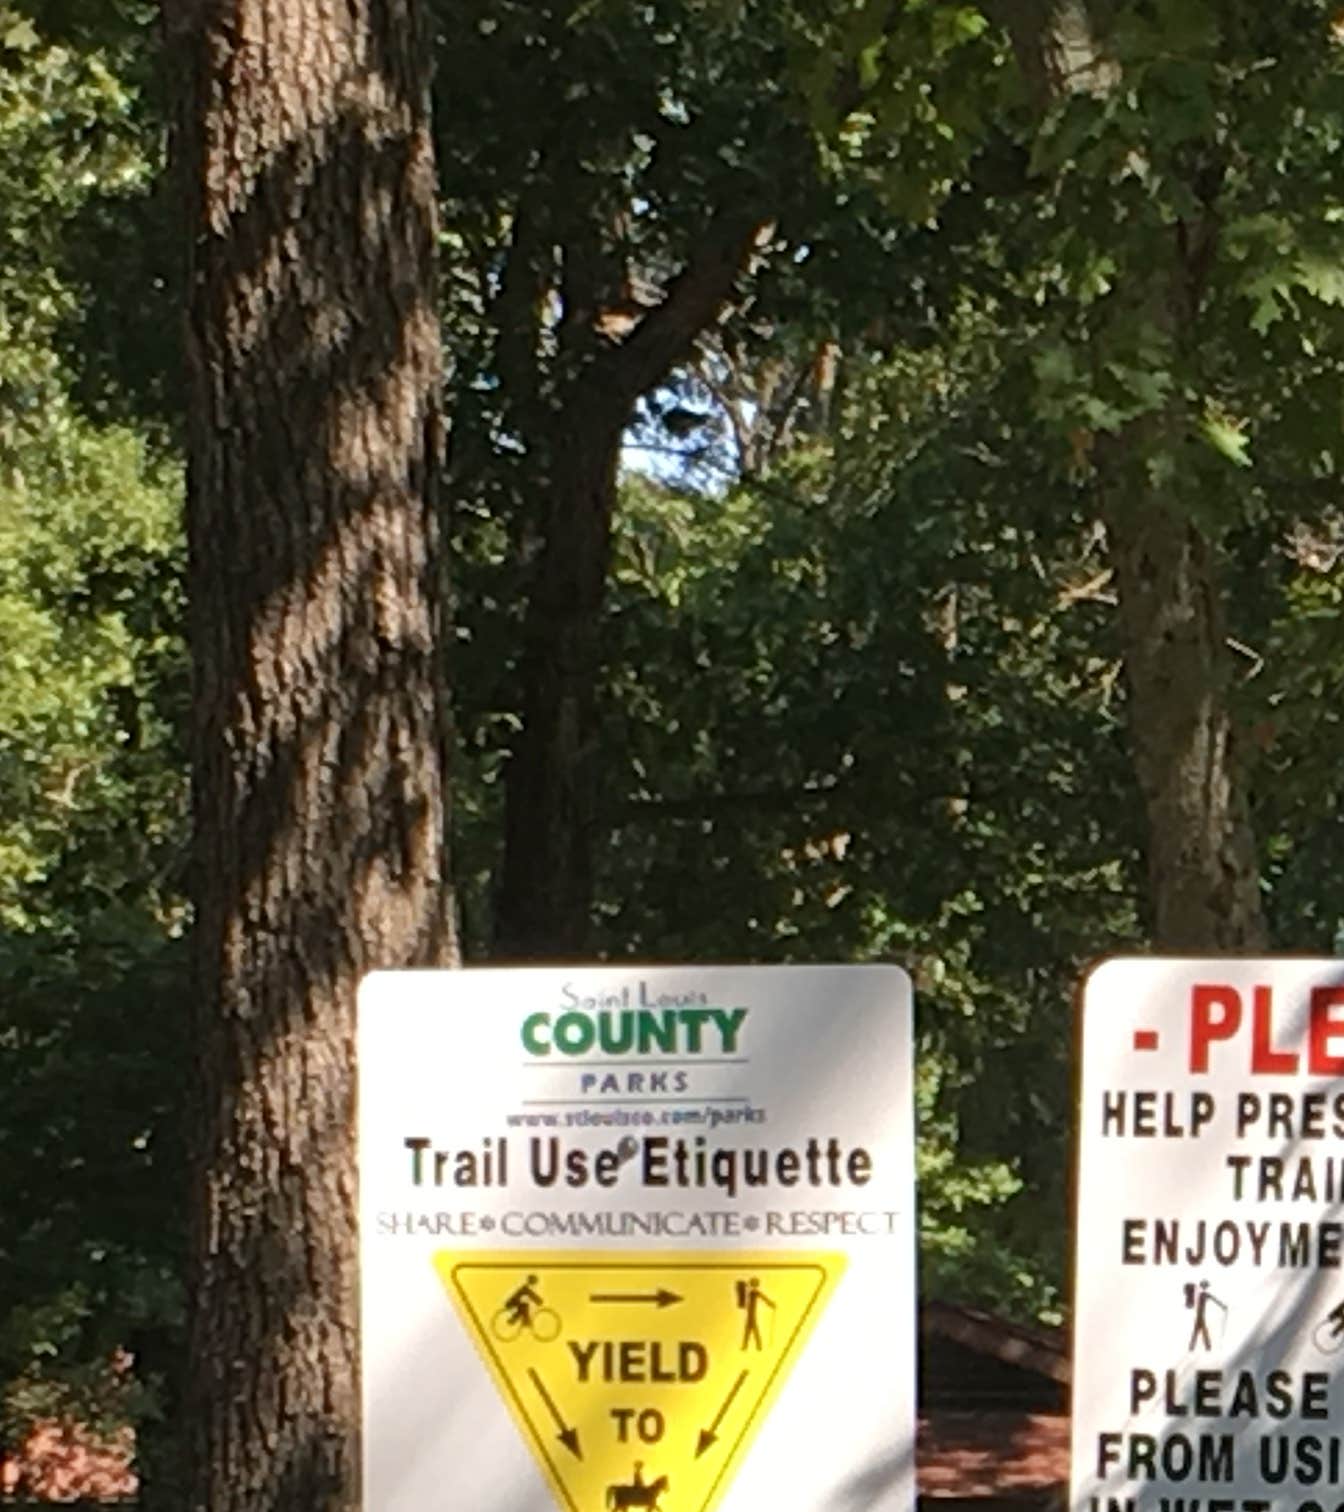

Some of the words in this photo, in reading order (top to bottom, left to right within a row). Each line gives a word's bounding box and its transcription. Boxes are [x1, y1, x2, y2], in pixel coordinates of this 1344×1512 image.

[561, 982, 630, 1011] Saint
[640, 982, 707, 1009] Louis
[521, 1008, 748, 1057] COUNTY
[581, 1072, 689, 1093] PARKS
[1101, 1091, 1215, 1138] HELP
[404, 1137, 507, 1187] Trail
[531, 1137, 620, 1188] Use
[642, 1136, 873, 1196] Etiquette
[376, 1211, 481, 1235] SHARE
[501, 1211, 741, 1236] COMMUNICATE
[766, 1211, 900, 1235] RESPECT
[568, 1341, 709, 1383] YIELD
[1130, 1369, 1330, 1420] PLEASE
[611, 1409, 665, 1445] TO
[1095, 1432, 1235, 1483] FROM
